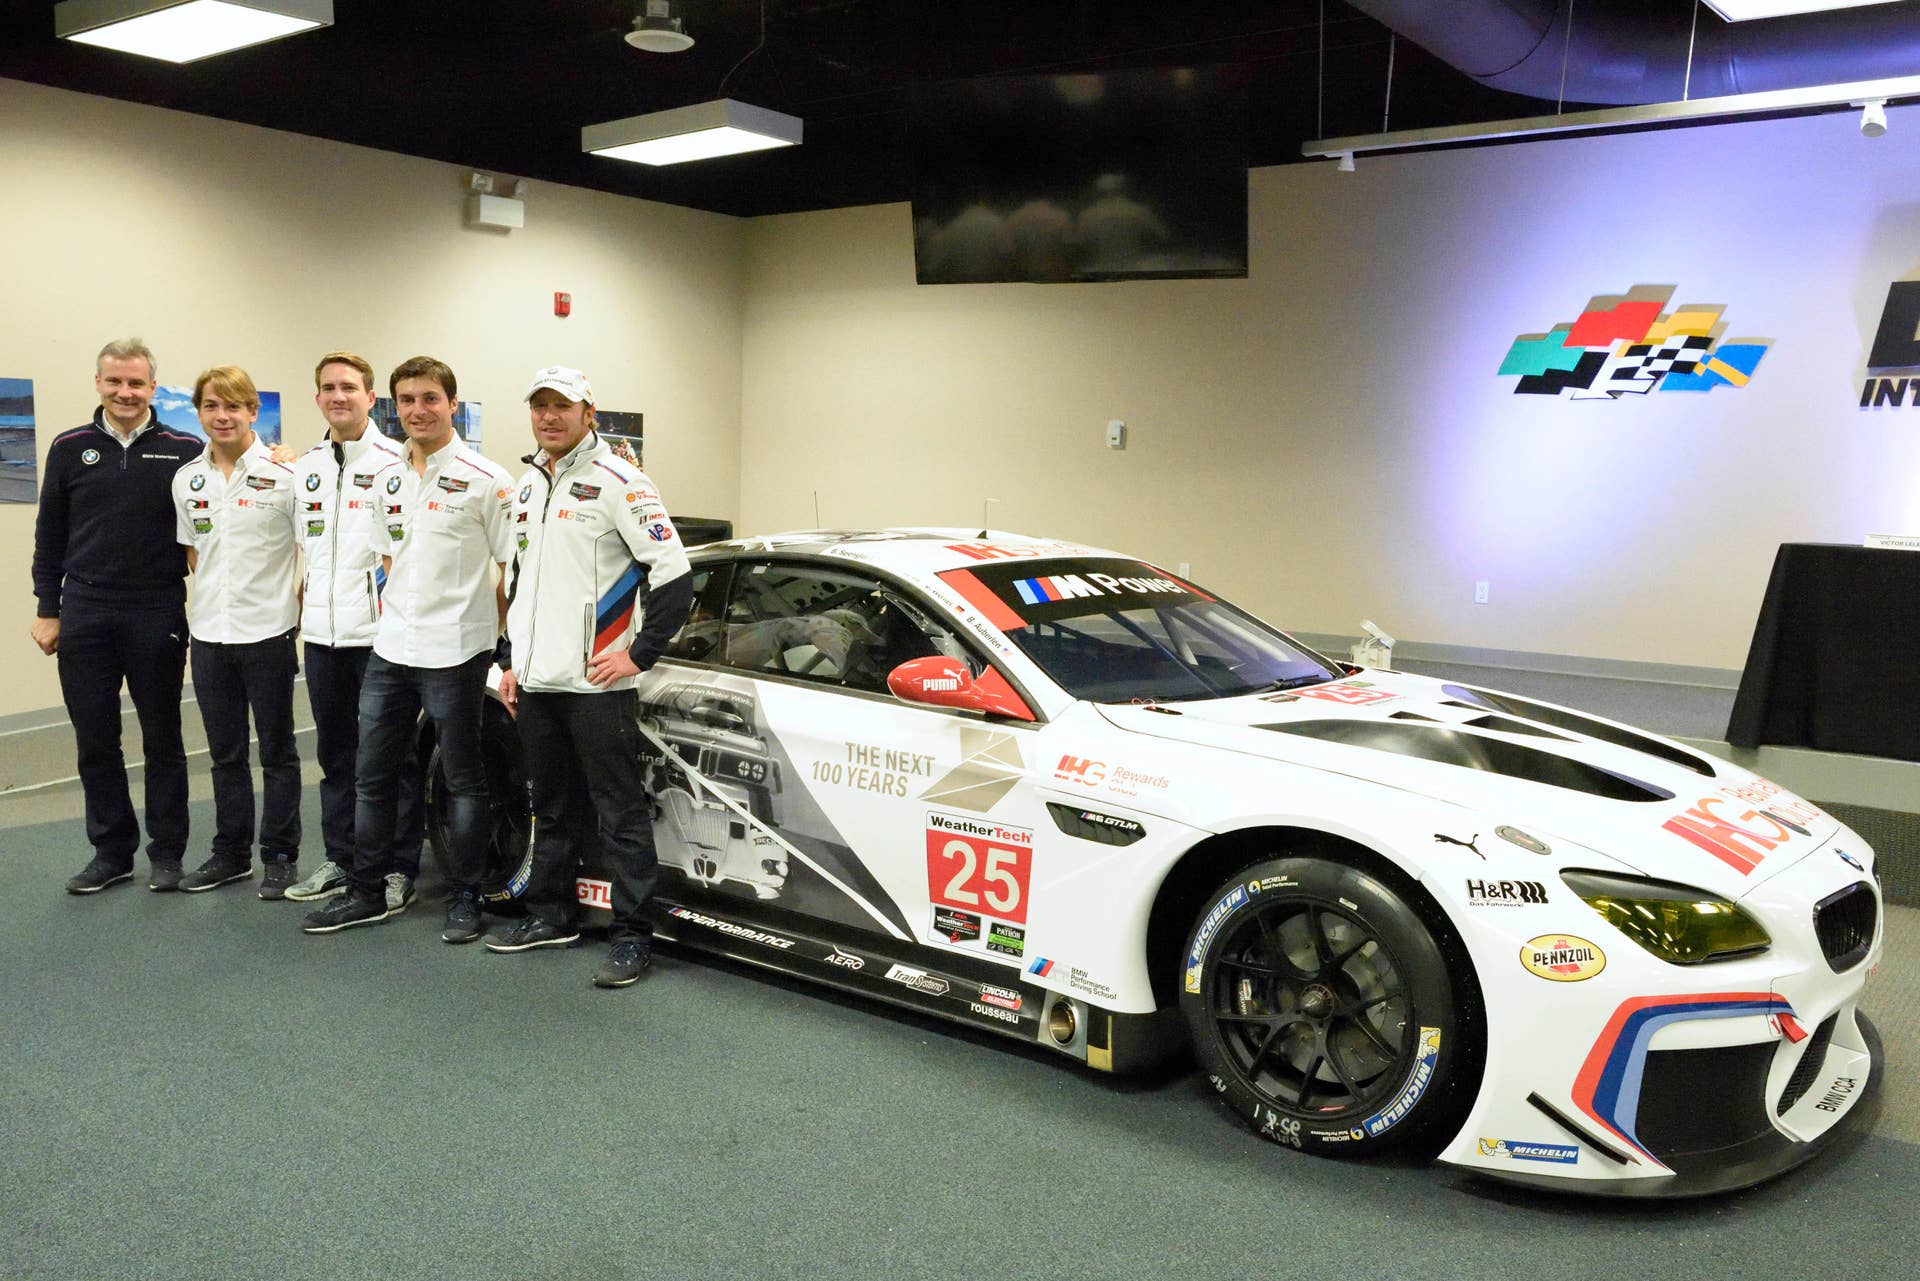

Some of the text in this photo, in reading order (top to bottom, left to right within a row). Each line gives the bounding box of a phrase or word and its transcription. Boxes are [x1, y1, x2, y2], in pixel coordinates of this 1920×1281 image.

[1086, 573, 1189, 595] Power
[923, 678, 958, 692] PUMA
[846, 741, 936, 778] THE NEXT
[812, 760, 909, 798] 100 YEARS
[1113, 766, 1169, 789] Rewards
[930, 815, 1033, 844] WeatherTech
[1104, 817, 1138, 830] GTLM
[942, 839, 1021, 913] 25
[1467, 879, 1518, 900] H&R
[1192, 888, 1242, 961] MICHELIN
[824, 954, 864, 970] AERO
[1533, 948, 1595, 967] PENNZOIL
[1070, 974, 1110, 992] Performance
[1071, 967, 1089, 978] BMW
[982, 985, 1017, 1000] LINCOLN
[1070, 981, 1117, 1000] Driving School
[970, 1002, 1019, 1024] rousseau
[1370, 1062, 1431, 1134] MICHELIN
[1815, 1075, 1857, 1113] BMW CCA
[1512, 1146, 1578, 1158] MICHELIN
